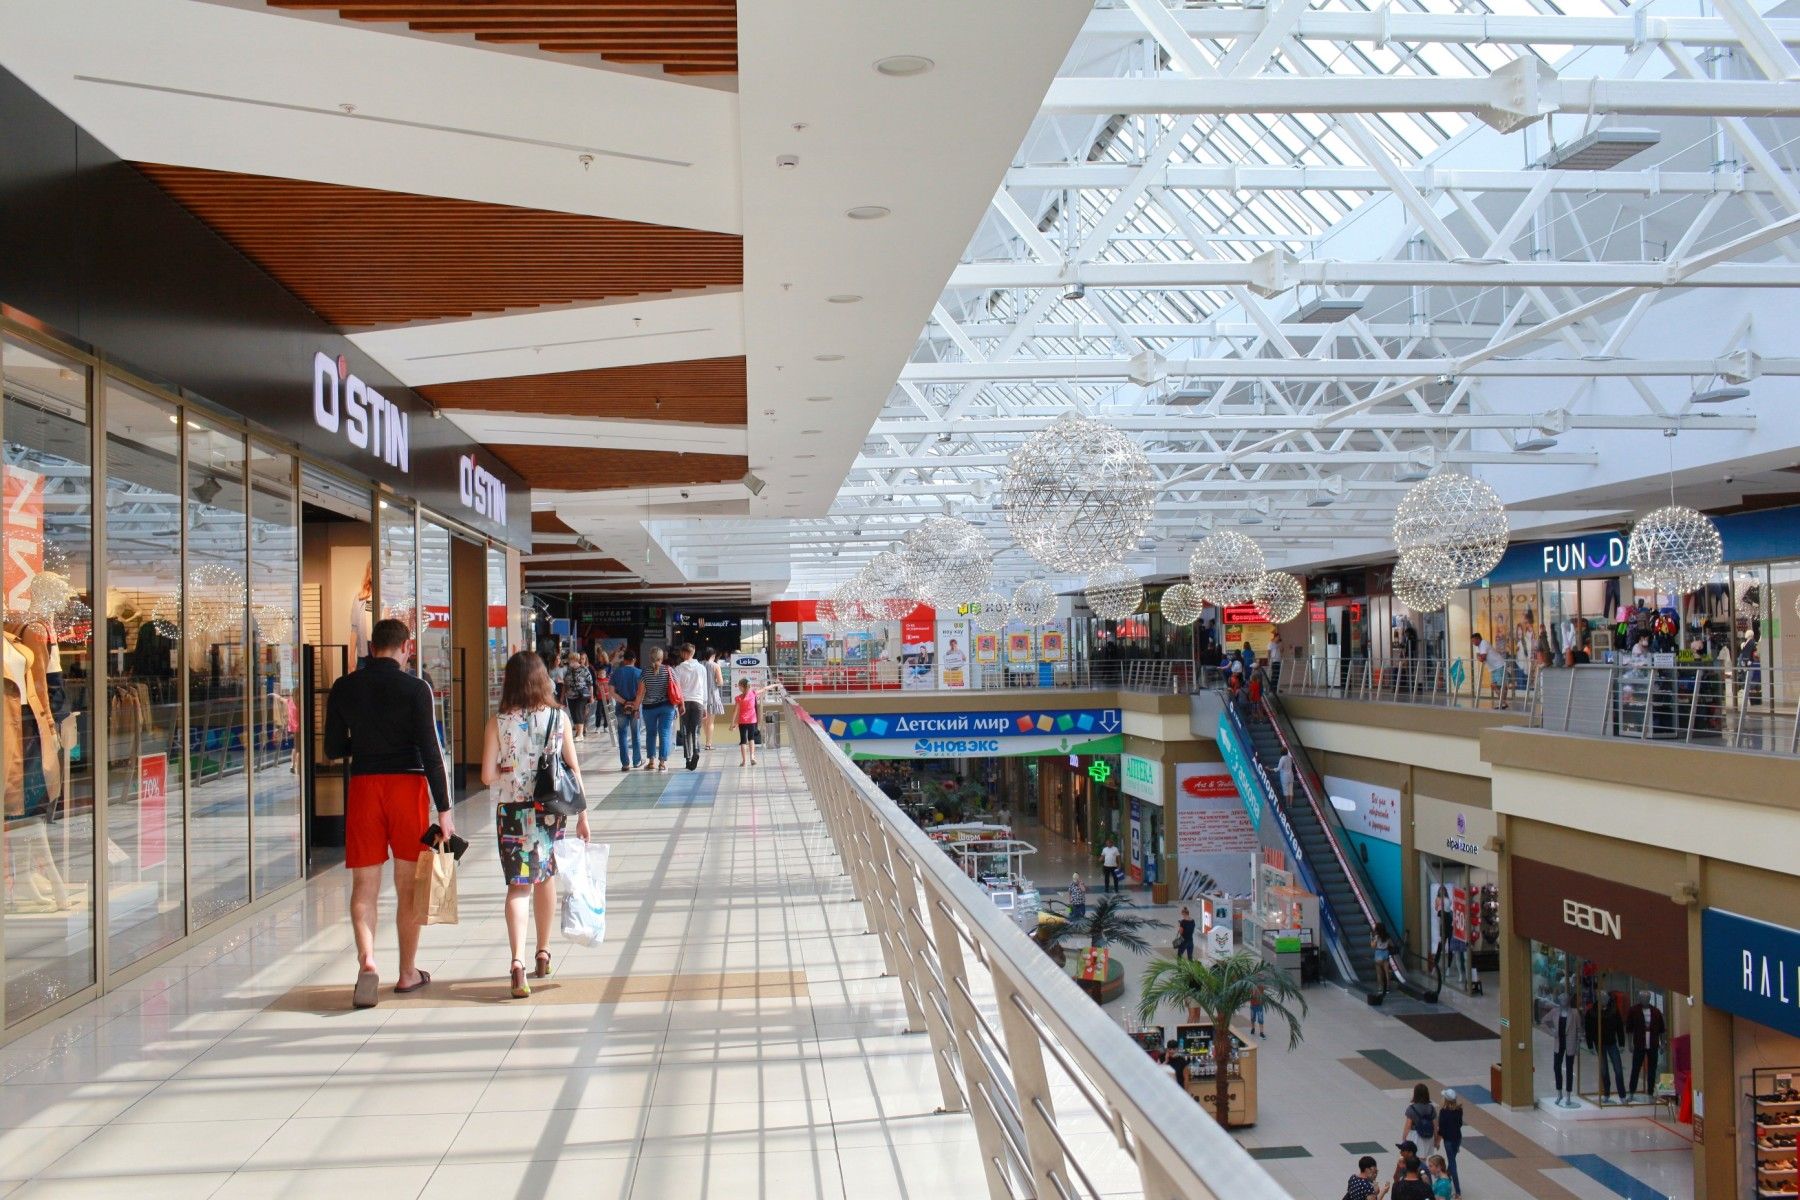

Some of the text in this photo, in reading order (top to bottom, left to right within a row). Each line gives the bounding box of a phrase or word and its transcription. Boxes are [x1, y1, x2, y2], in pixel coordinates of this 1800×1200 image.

[314, 351, 409, 473] O'STIN
[460, 453, 507, 527] O'STIN
[1543, 541, 1586, 574] FUN
[896, 716, 1010, 733] Детский мир
[934, 740, 999, 752] НОВЭКС
[1126, 757, 1154, 785] АПТЕКА
